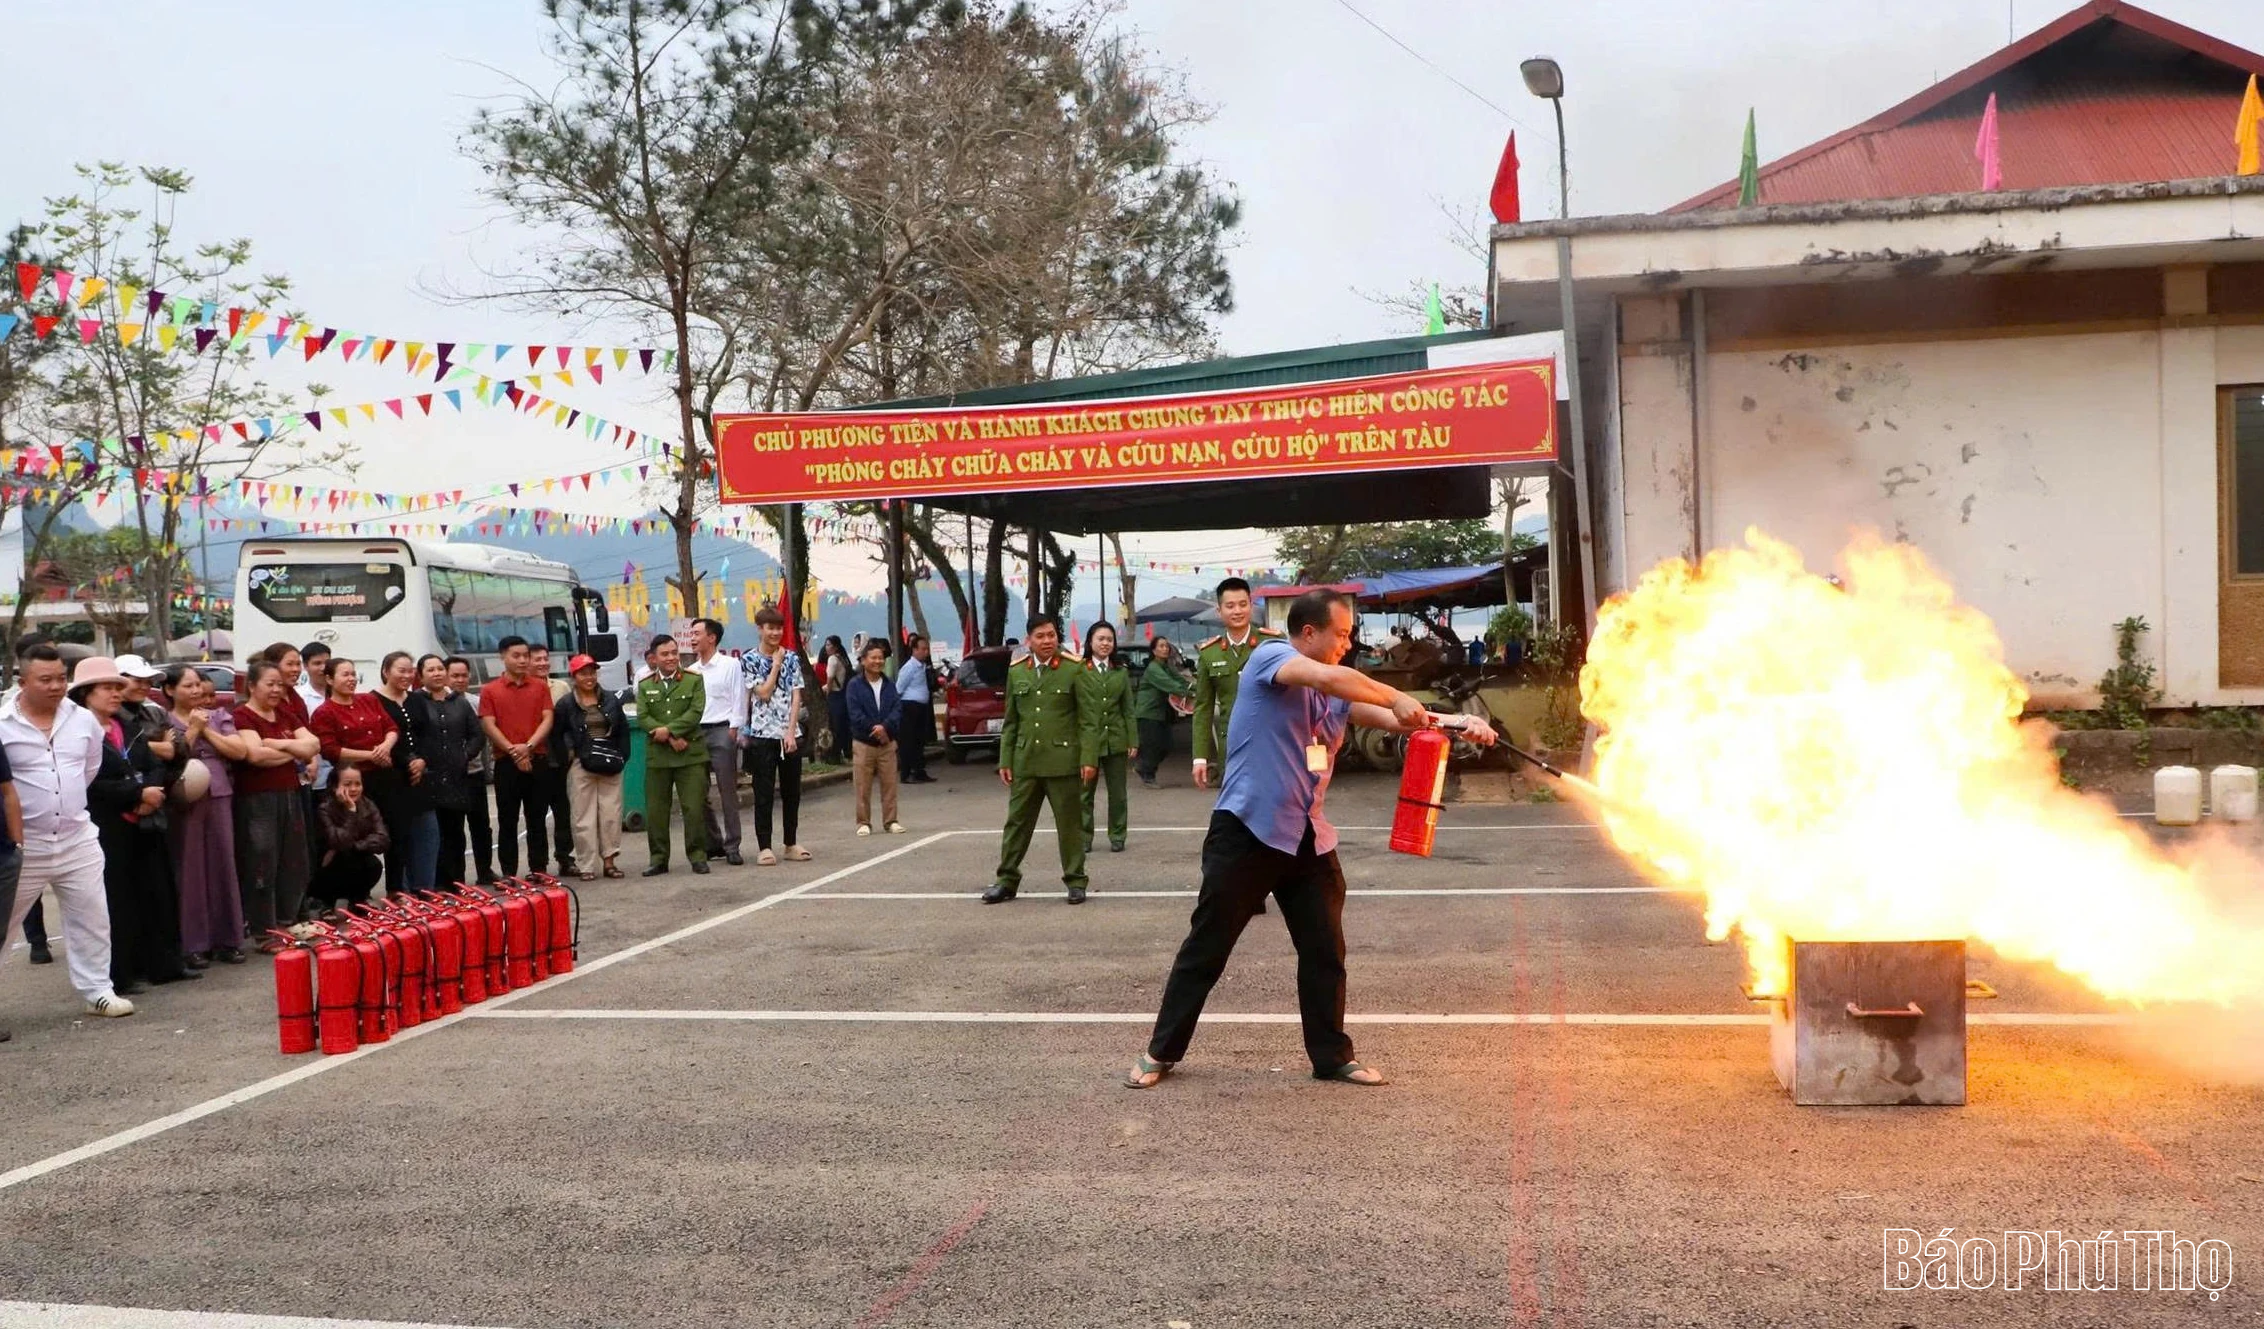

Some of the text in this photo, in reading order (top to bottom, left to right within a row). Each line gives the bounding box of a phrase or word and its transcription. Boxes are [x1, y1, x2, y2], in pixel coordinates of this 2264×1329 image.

[753, 378, 1509, 452] CHỦ PHƯƠNG TIỆN VÀ HÀNH KHÁCH CHUNG TAY THỰC HIỆN CÔNG TÁC
[805, 421, 1451, 484] "PHÒNG CHÁY CHỮA CHÁY VÀ CỨU NẠN, CỨU HỘ" TRÊN TÀU
